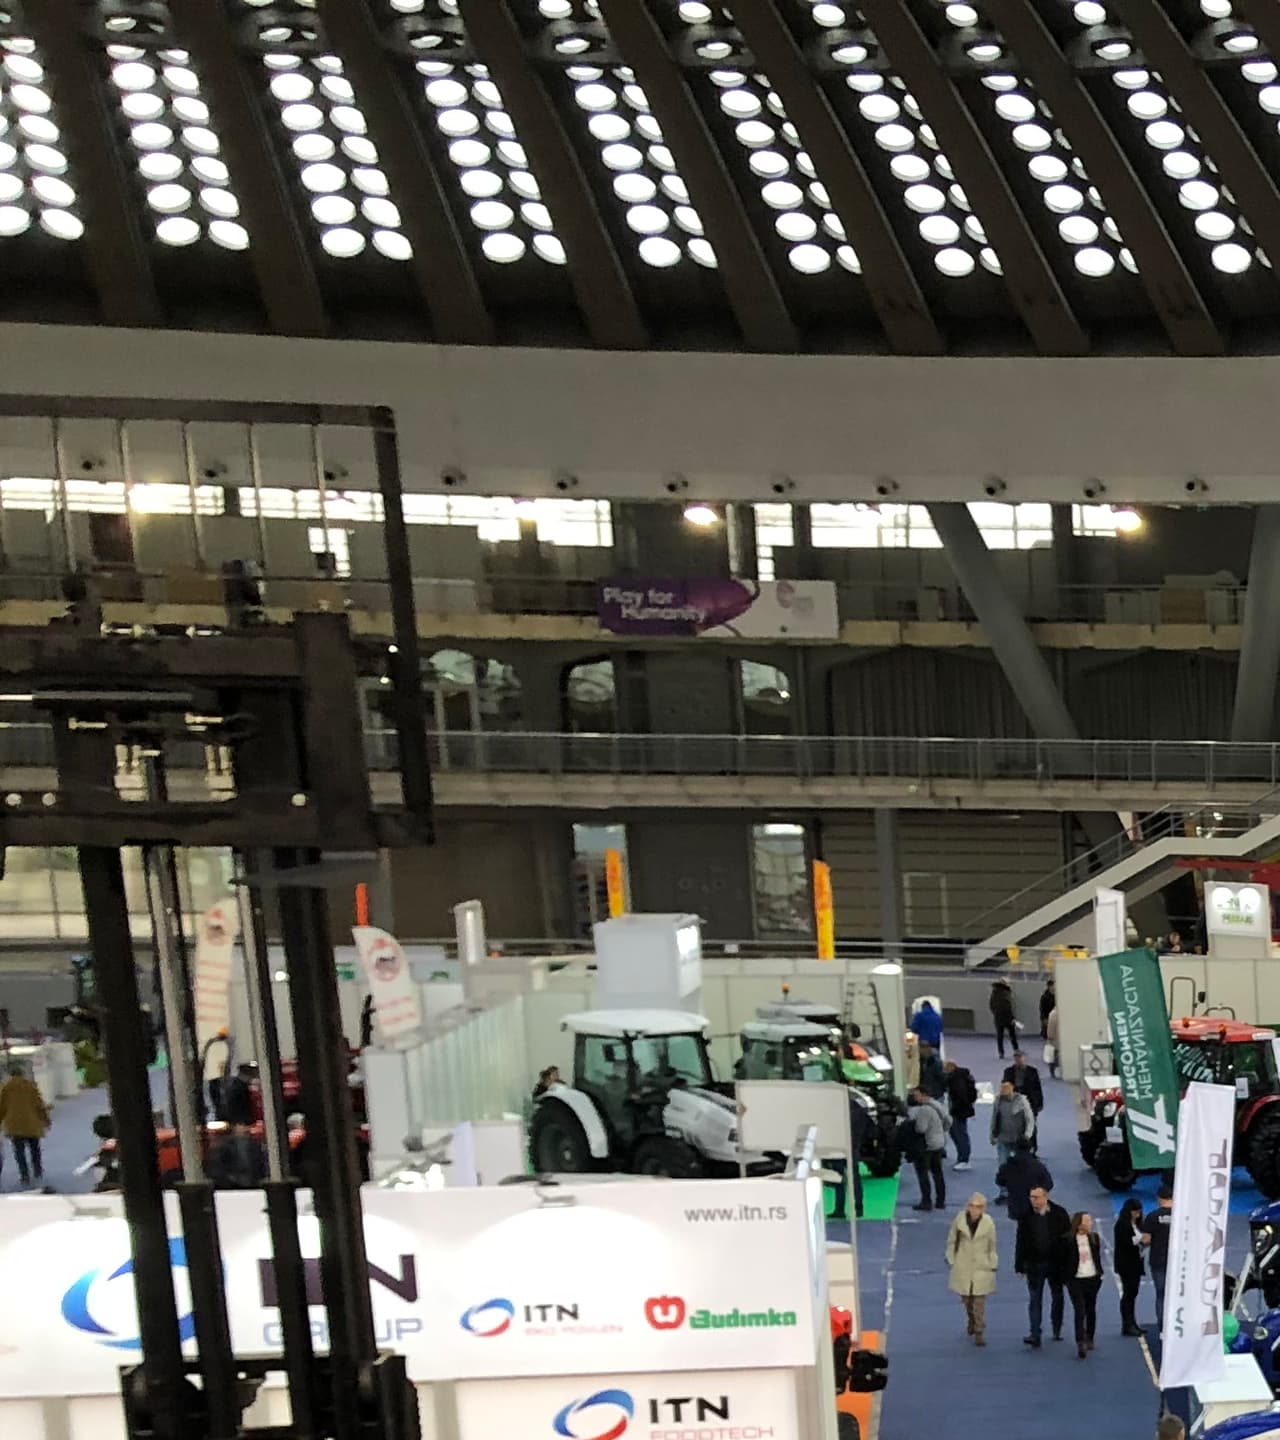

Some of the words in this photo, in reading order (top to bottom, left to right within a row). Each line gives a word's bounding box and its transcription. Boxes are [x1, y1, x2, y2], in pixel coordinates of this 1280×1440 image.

[684, 1204, 787, 1222] www.itn.rs
[524, 1304, 580, 1322] ITN
[689, 1307, 797, 1330] Budimka
[649, 1396, 729, 1424] ITN
